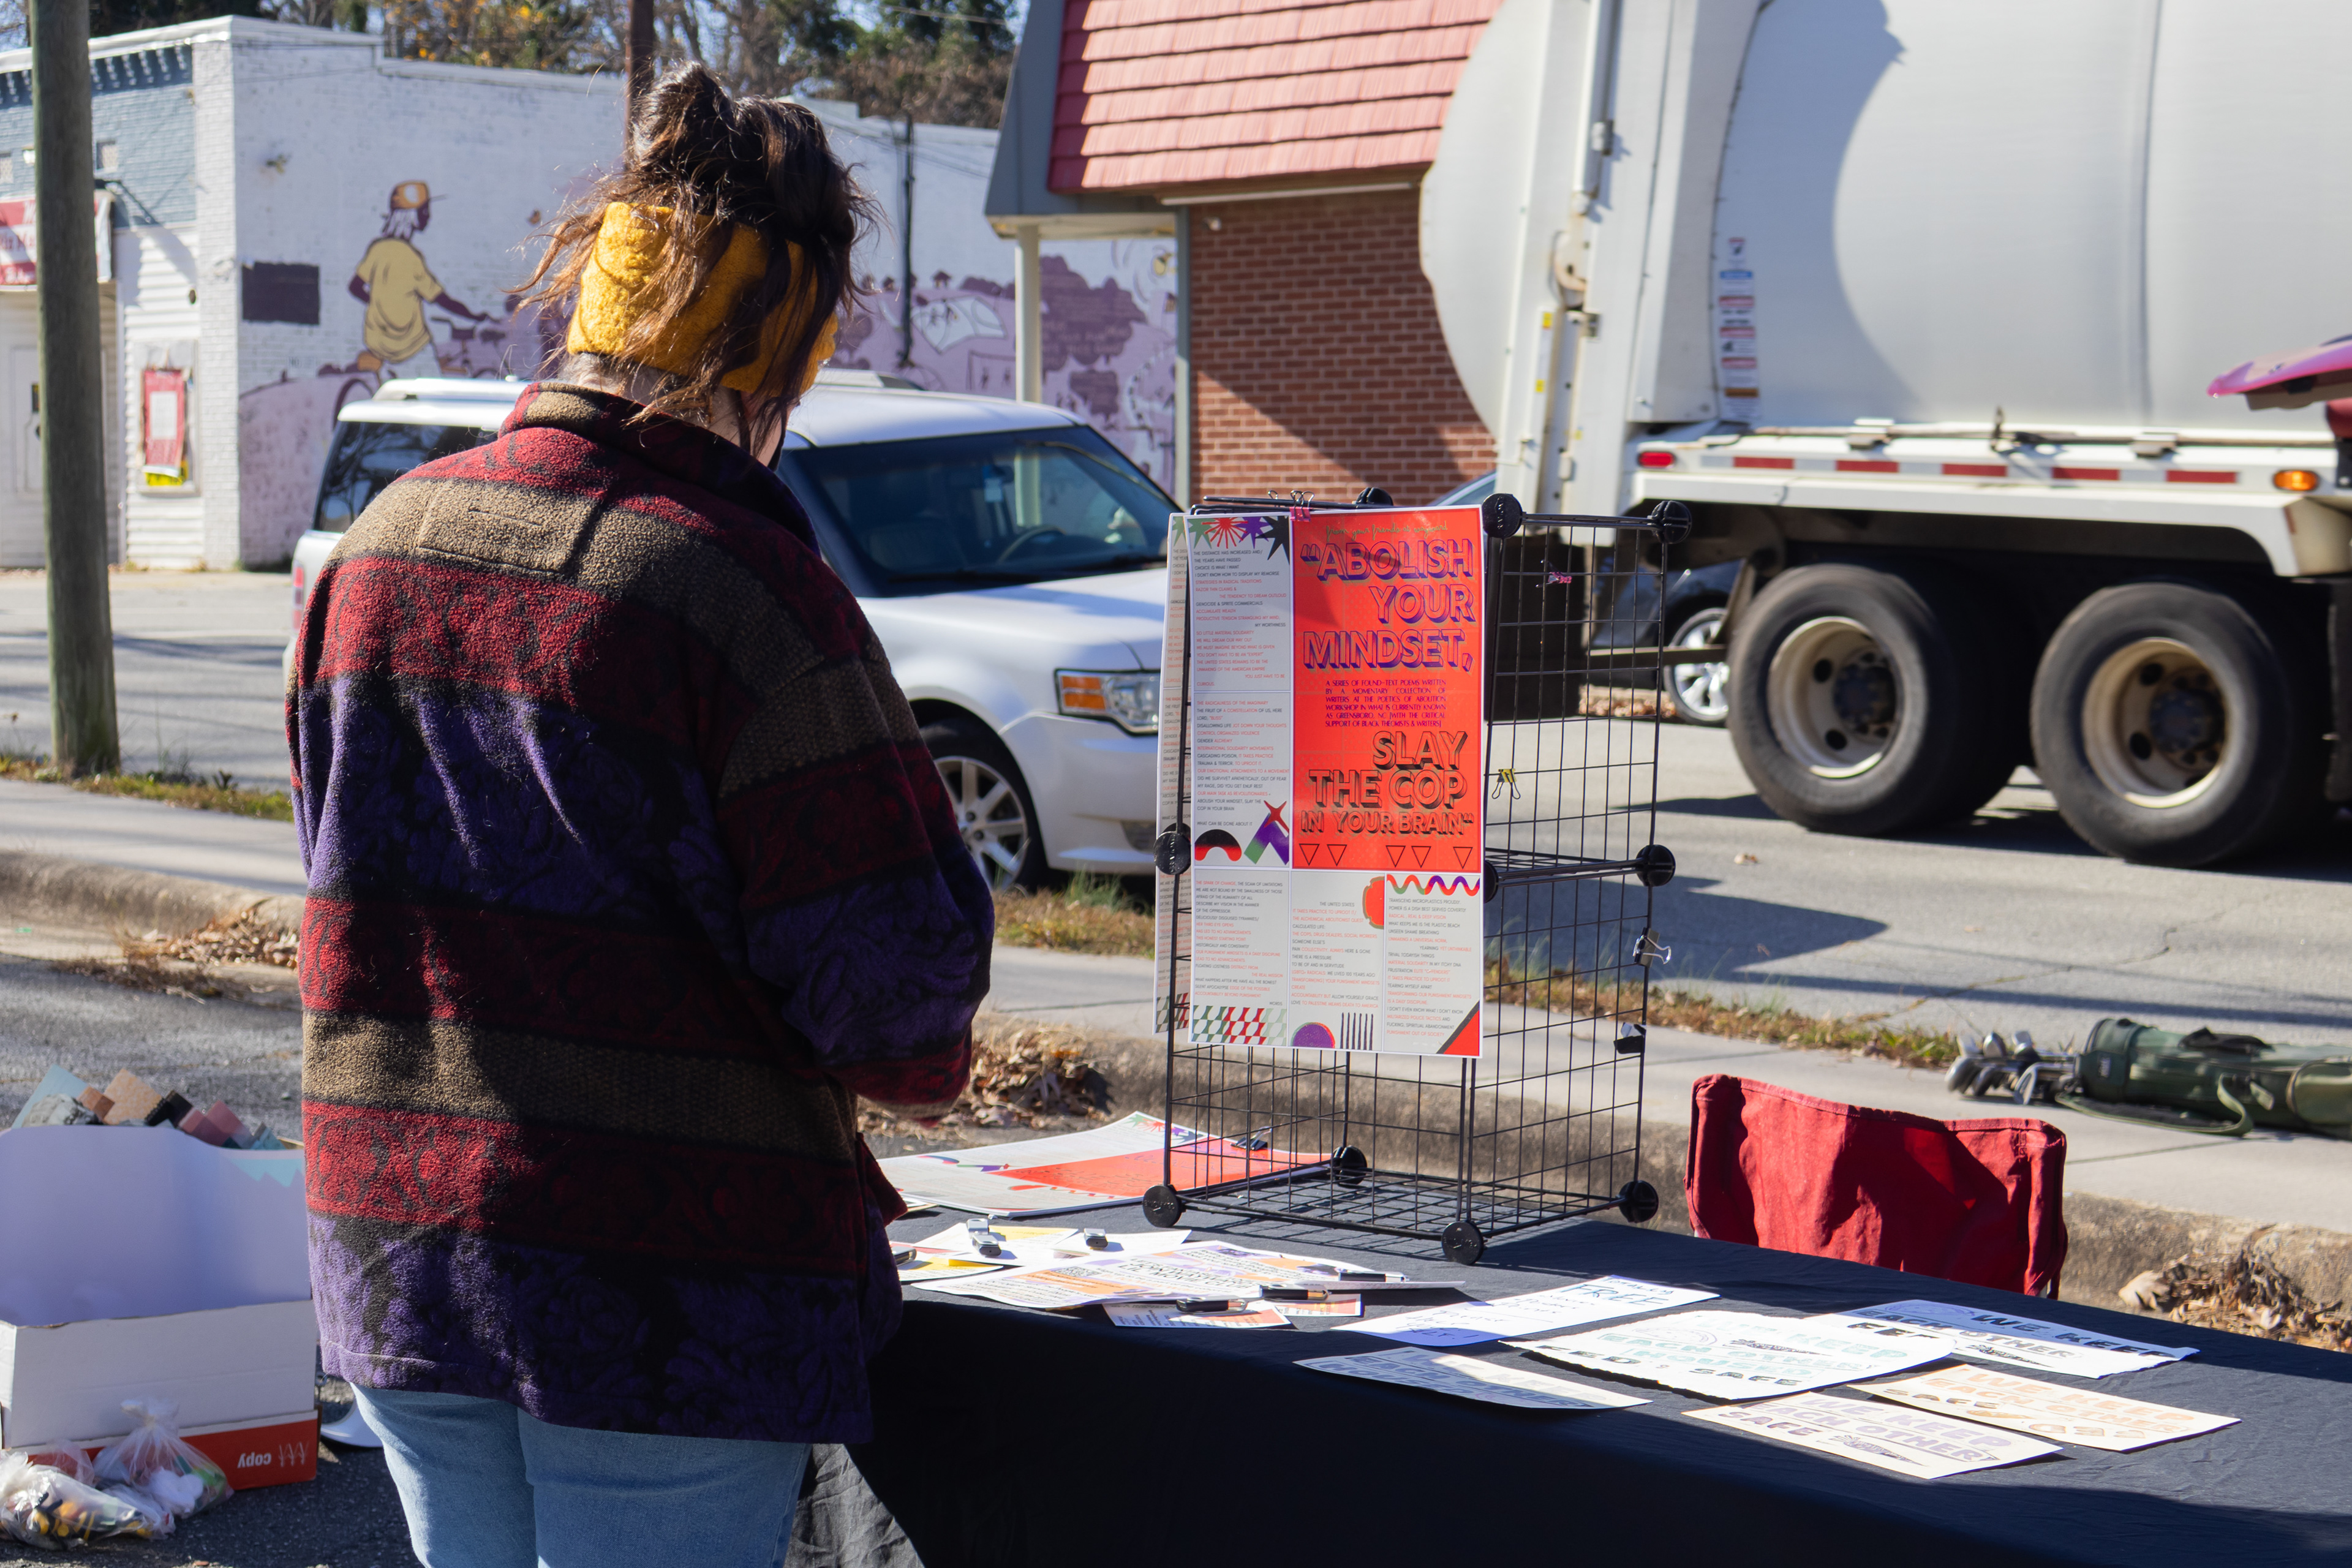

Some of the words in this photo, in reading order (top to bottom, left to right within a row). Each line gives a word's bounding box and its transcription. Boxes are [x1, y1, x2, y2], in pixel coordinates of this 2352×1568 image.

[1326, 526, 1349, 541] from
[1352, 528, 1369, 541] your
[1372, 523, 1400, 540] friends
[1414, 521, 1448, 539] wayward
[1369, 584, 1476, 624] YOUR
[1303, 629, 1474, 672] MINDSET,
[1373, 731, 1468, 770] SLAY
[1309, 770, 1382, 808] THE
[1389, 770, 1467, 809] COP
[1301, 810, 1324, 833] IN
[1332, 811, 1395, 834] YOUR
[1150, 1271, 1203, 1283] MOVIE
[1204, 1280, 1251, 1289] CLUB
[1559, 1284, 1669, 1305] FREE
[1599, 1334, 1713, 1353] EACH
[1727, 1350, 1862, 1371] OTHER
[1785, 1333, 1909, 1359] KEEP
[1856, 1310, 1954, 1330] EACH
[1959, 1330, 2076, 1359] OTHER
[1971, 1314, 2051, 1332] WE
[2054, 1332, 2177, 1359] KEEP
[1318, 1362, 1477, 1396] HOUSED
[1351, 1356, 1449, 1384] EACH
[1455, 1378, 1583, 1408] OTHER
[1536, 1344, 1642, 1365] FED
[1689, 1367, 1802, 1386] SAFE
[1634, 1351, 1814, 1376] HOUSED
[1883, 1389, 2001, 1409] SAFE
[1925, 1380, 2035, 1405] EACH
[2046, 1404, 2183, 1433] OTHER
[1967, 1373, 2052, 1393] WE
[2060, 1393, 2195, 1421] KEEP
[1717, 1411, 1823, 1436] SAFE
[1749, 1403, 1851, 1427] EACH
[1855, 1425, 1983, 1462] OTHER
[1800, 1399, 1884, 1416] WE
[1883, 1414, 2012, 1447] KEEP
[237, 1451, 272, 1469] copy
